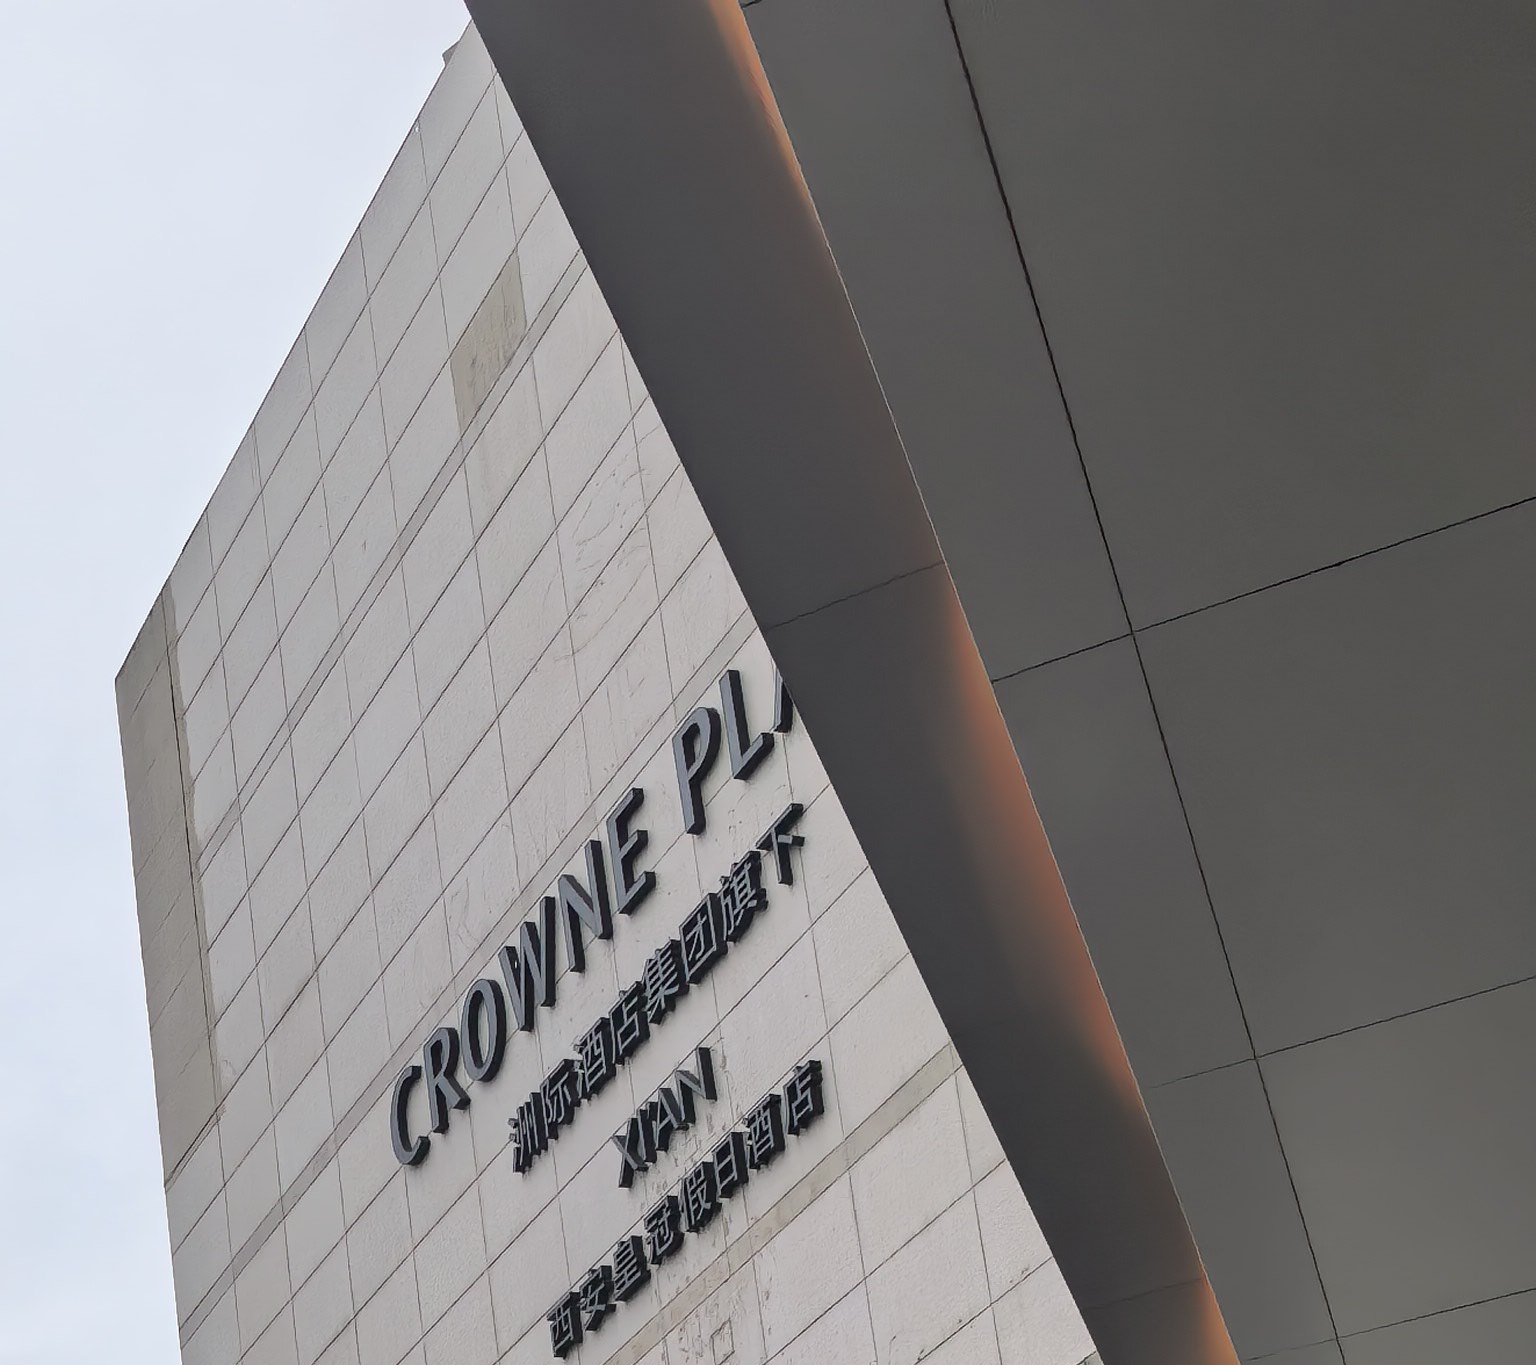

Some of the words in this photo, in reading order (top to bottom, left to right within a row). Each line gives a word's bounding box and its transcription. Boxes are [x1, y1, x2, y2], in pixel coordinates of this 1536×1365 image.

[389, 787, 656, 1167] CROWNE
[508, 803, 805, 1173] 洲际酒店集团旗下
[546, 1061, 826, 1358] 西安皇冠假日酒店
